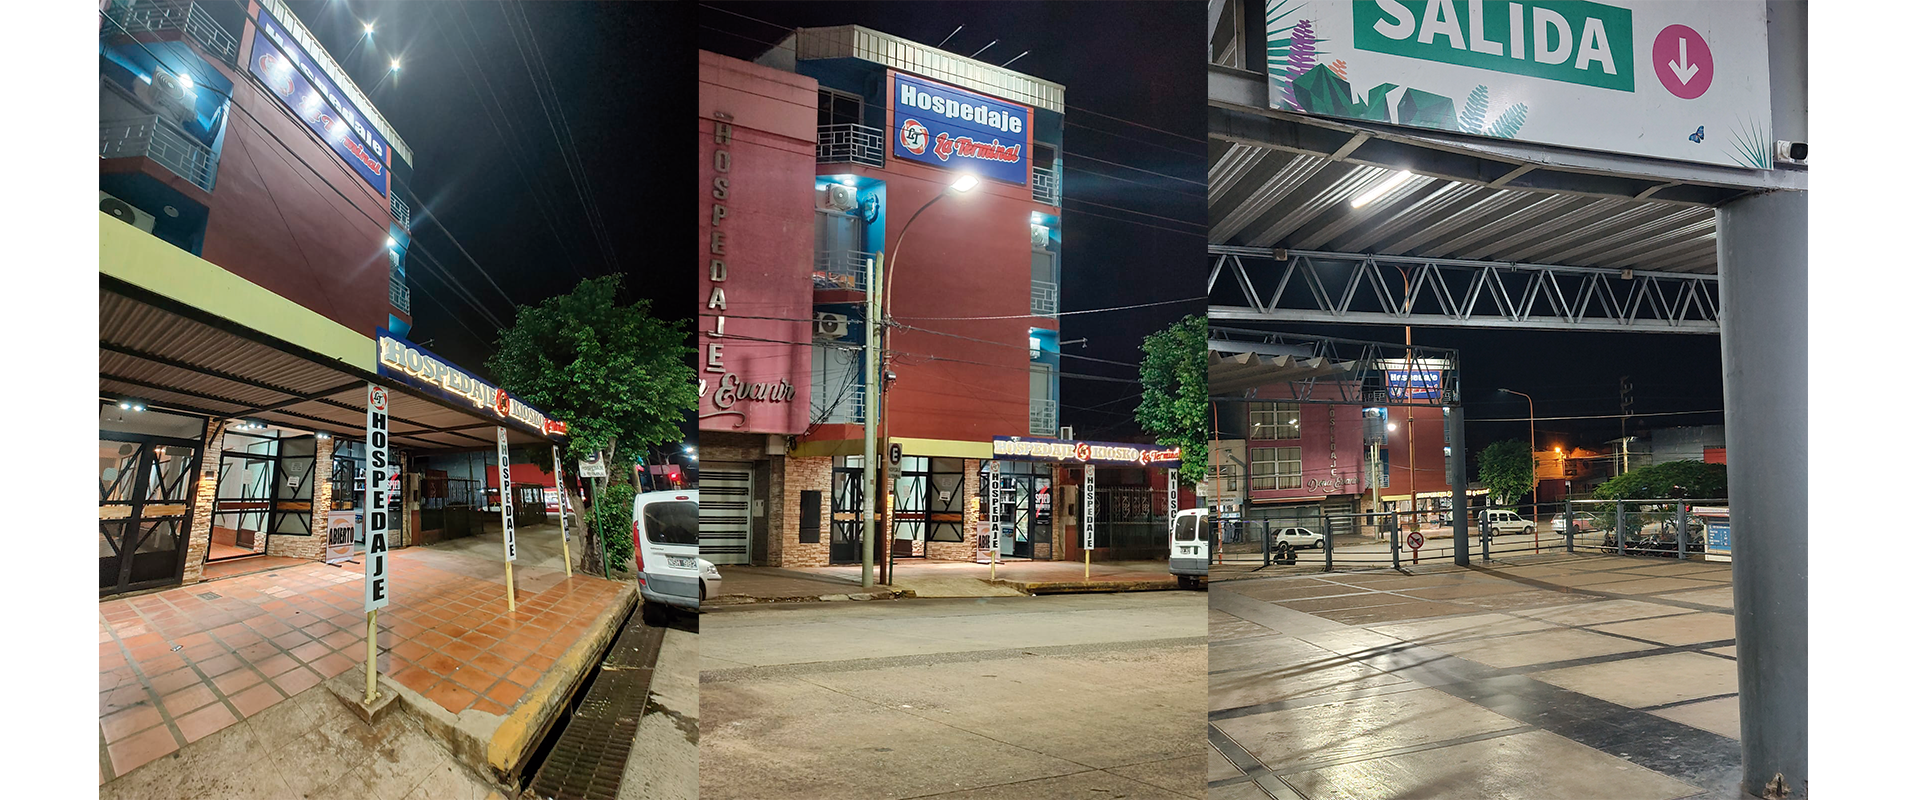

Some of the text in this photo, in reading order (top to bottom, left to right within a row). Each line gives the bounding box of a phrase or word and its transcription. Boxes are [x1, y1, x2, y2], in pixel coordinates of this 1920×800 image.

[1372, 0, 1618, 75] SALIDA
[901, 83, 1022, 134] Hospedaje
[933, 132, 1021, 164] La Terminal
[706, 120, 731, 370] HOSPEDAJE
[380, 335, 497, 409] HOSPEDAJE
[892, 447, 899, 462] E
[993, 440, 1076, 461] HOSPEDAJE
[1091, 445, 1140, 461] KIOSKO
[328, 526, 355, 546] ABIERTO
[371, 411, 387, 602] HOSPEDAJE
[501, 444, 515, 557] HOSPEDAJE
[991, 472, 999, 549] HOSPEDAJE
[1086, 476, 1094, 548] HOSPEDAJE
